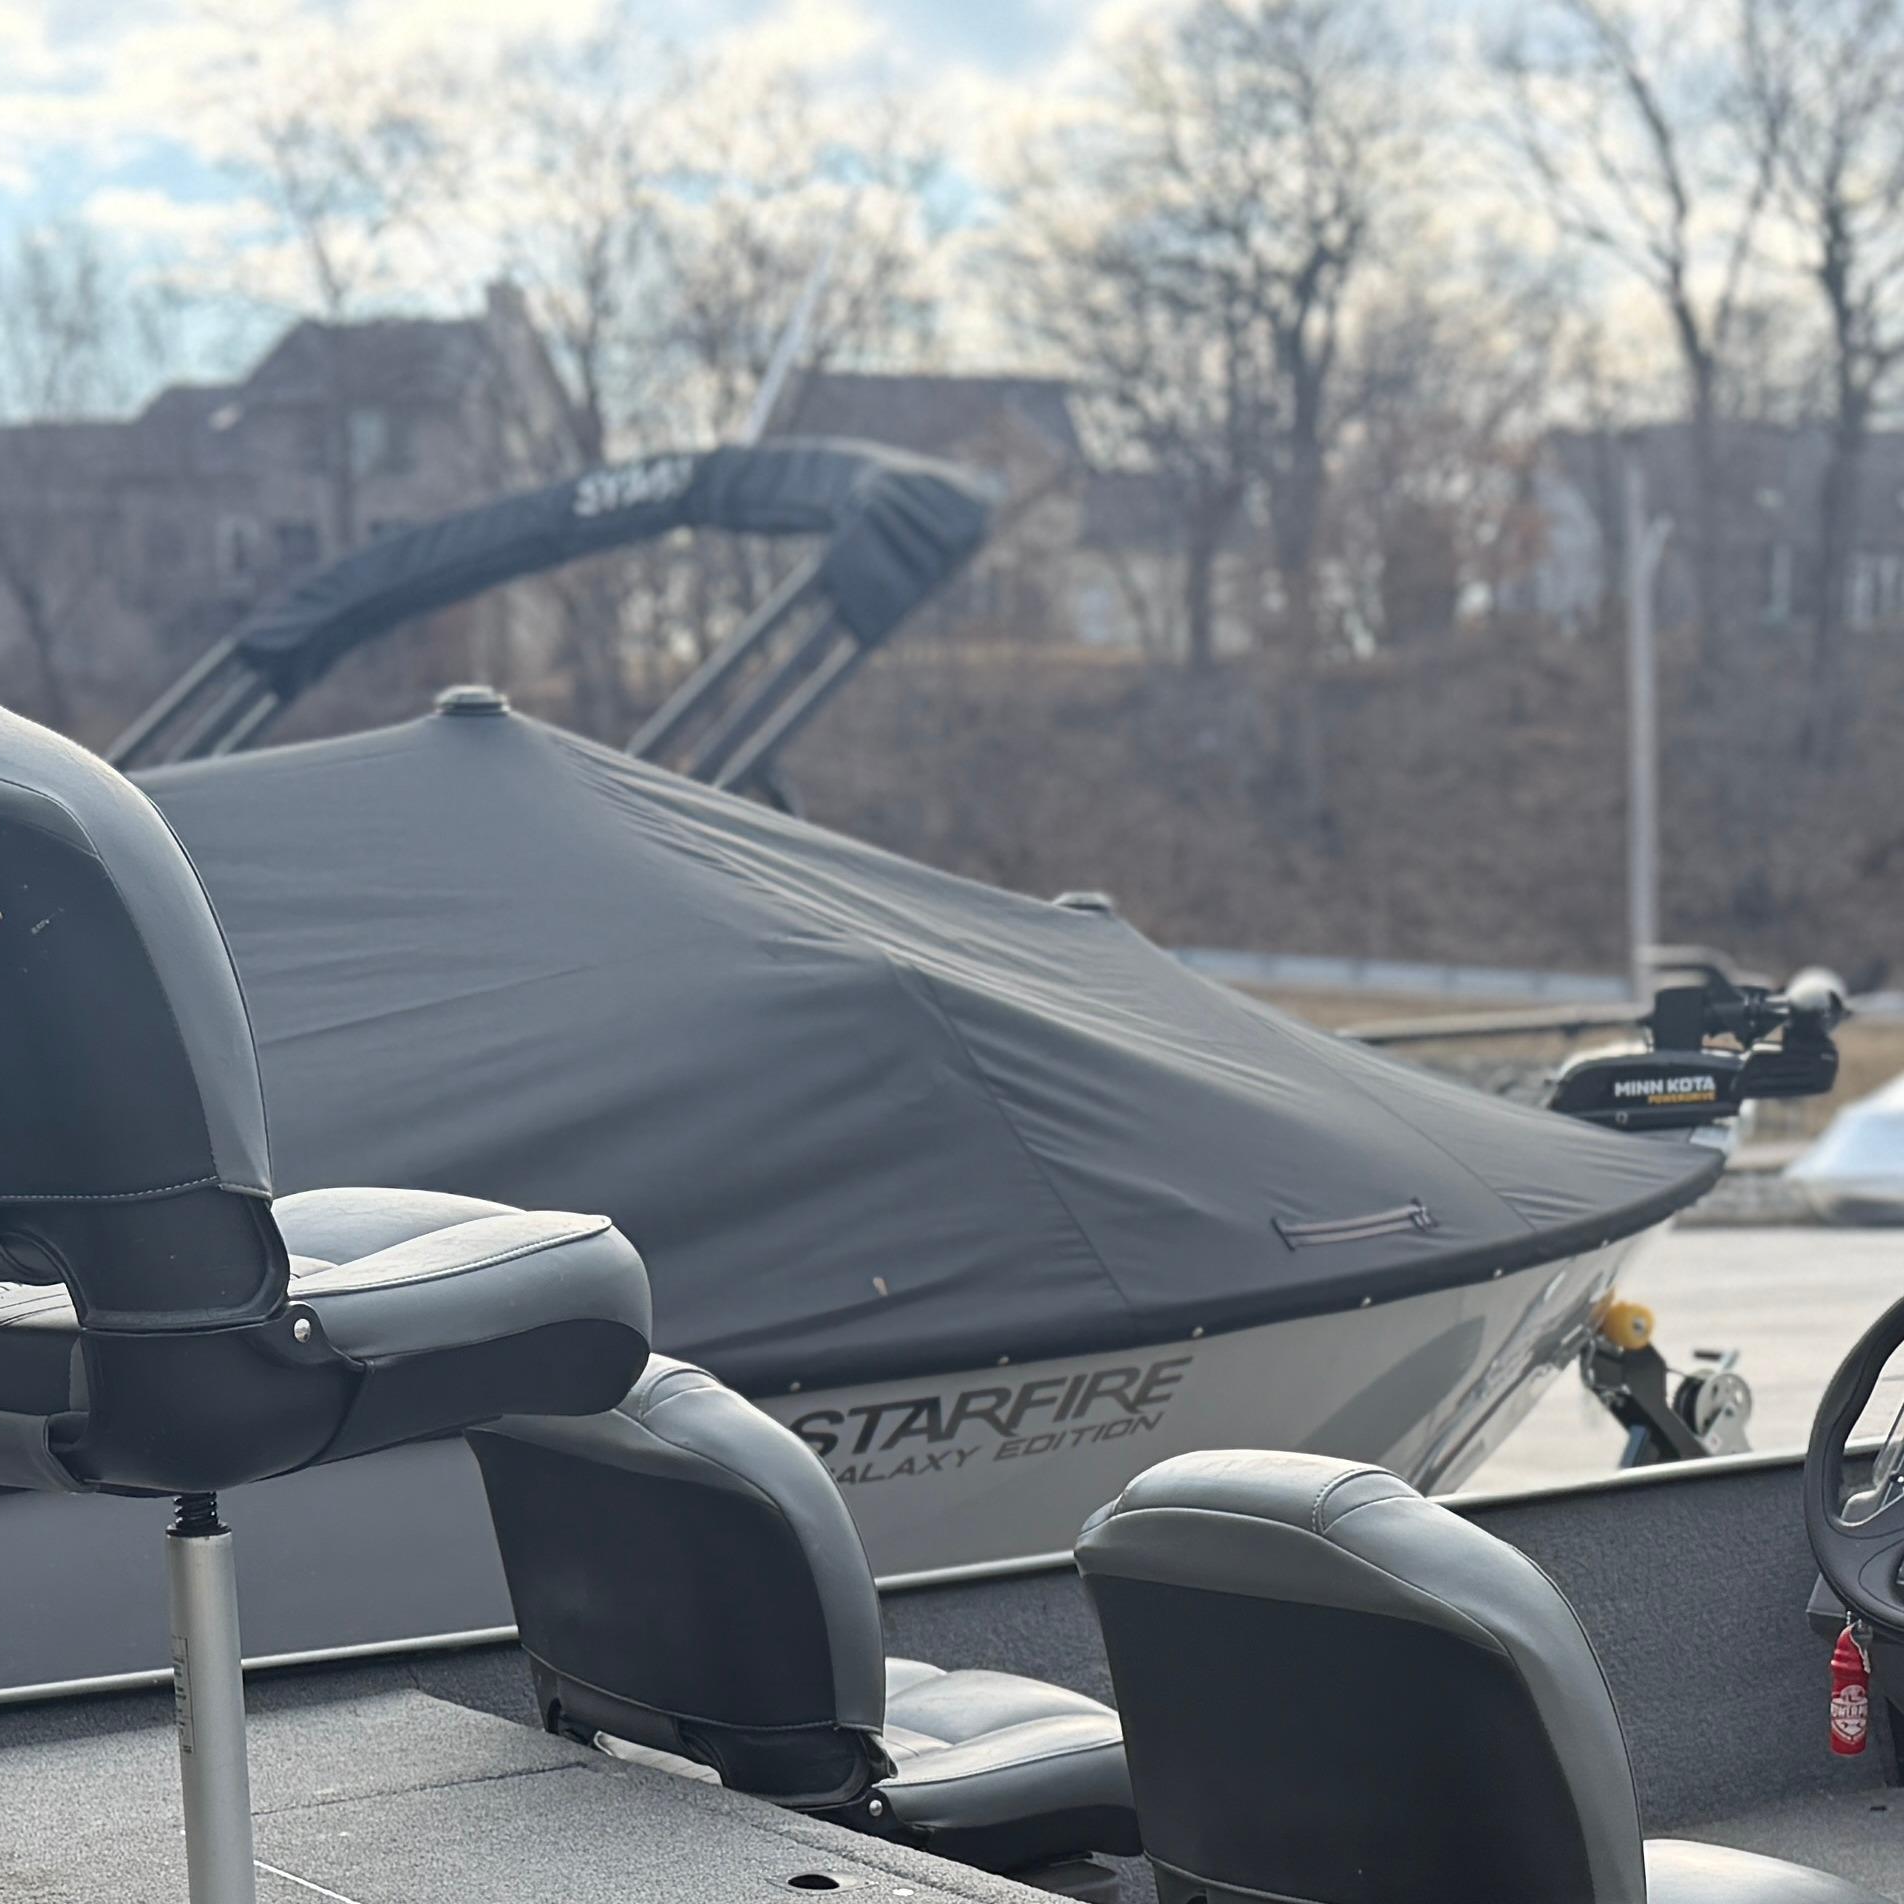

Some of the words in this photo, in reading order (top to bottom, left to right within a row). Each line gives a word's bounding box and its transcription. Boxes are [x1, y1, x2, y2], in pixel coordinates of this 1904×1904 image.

[1614, 1080, 1664, 1098] MINN
[1667, 1076, 1716, 1093] KOTA
[788, 1356, 1194, 1458] STARFIRE
[830, 1446, 981, 1486] ALAXY
[994, 1411, 1165, 1462] EDITION
